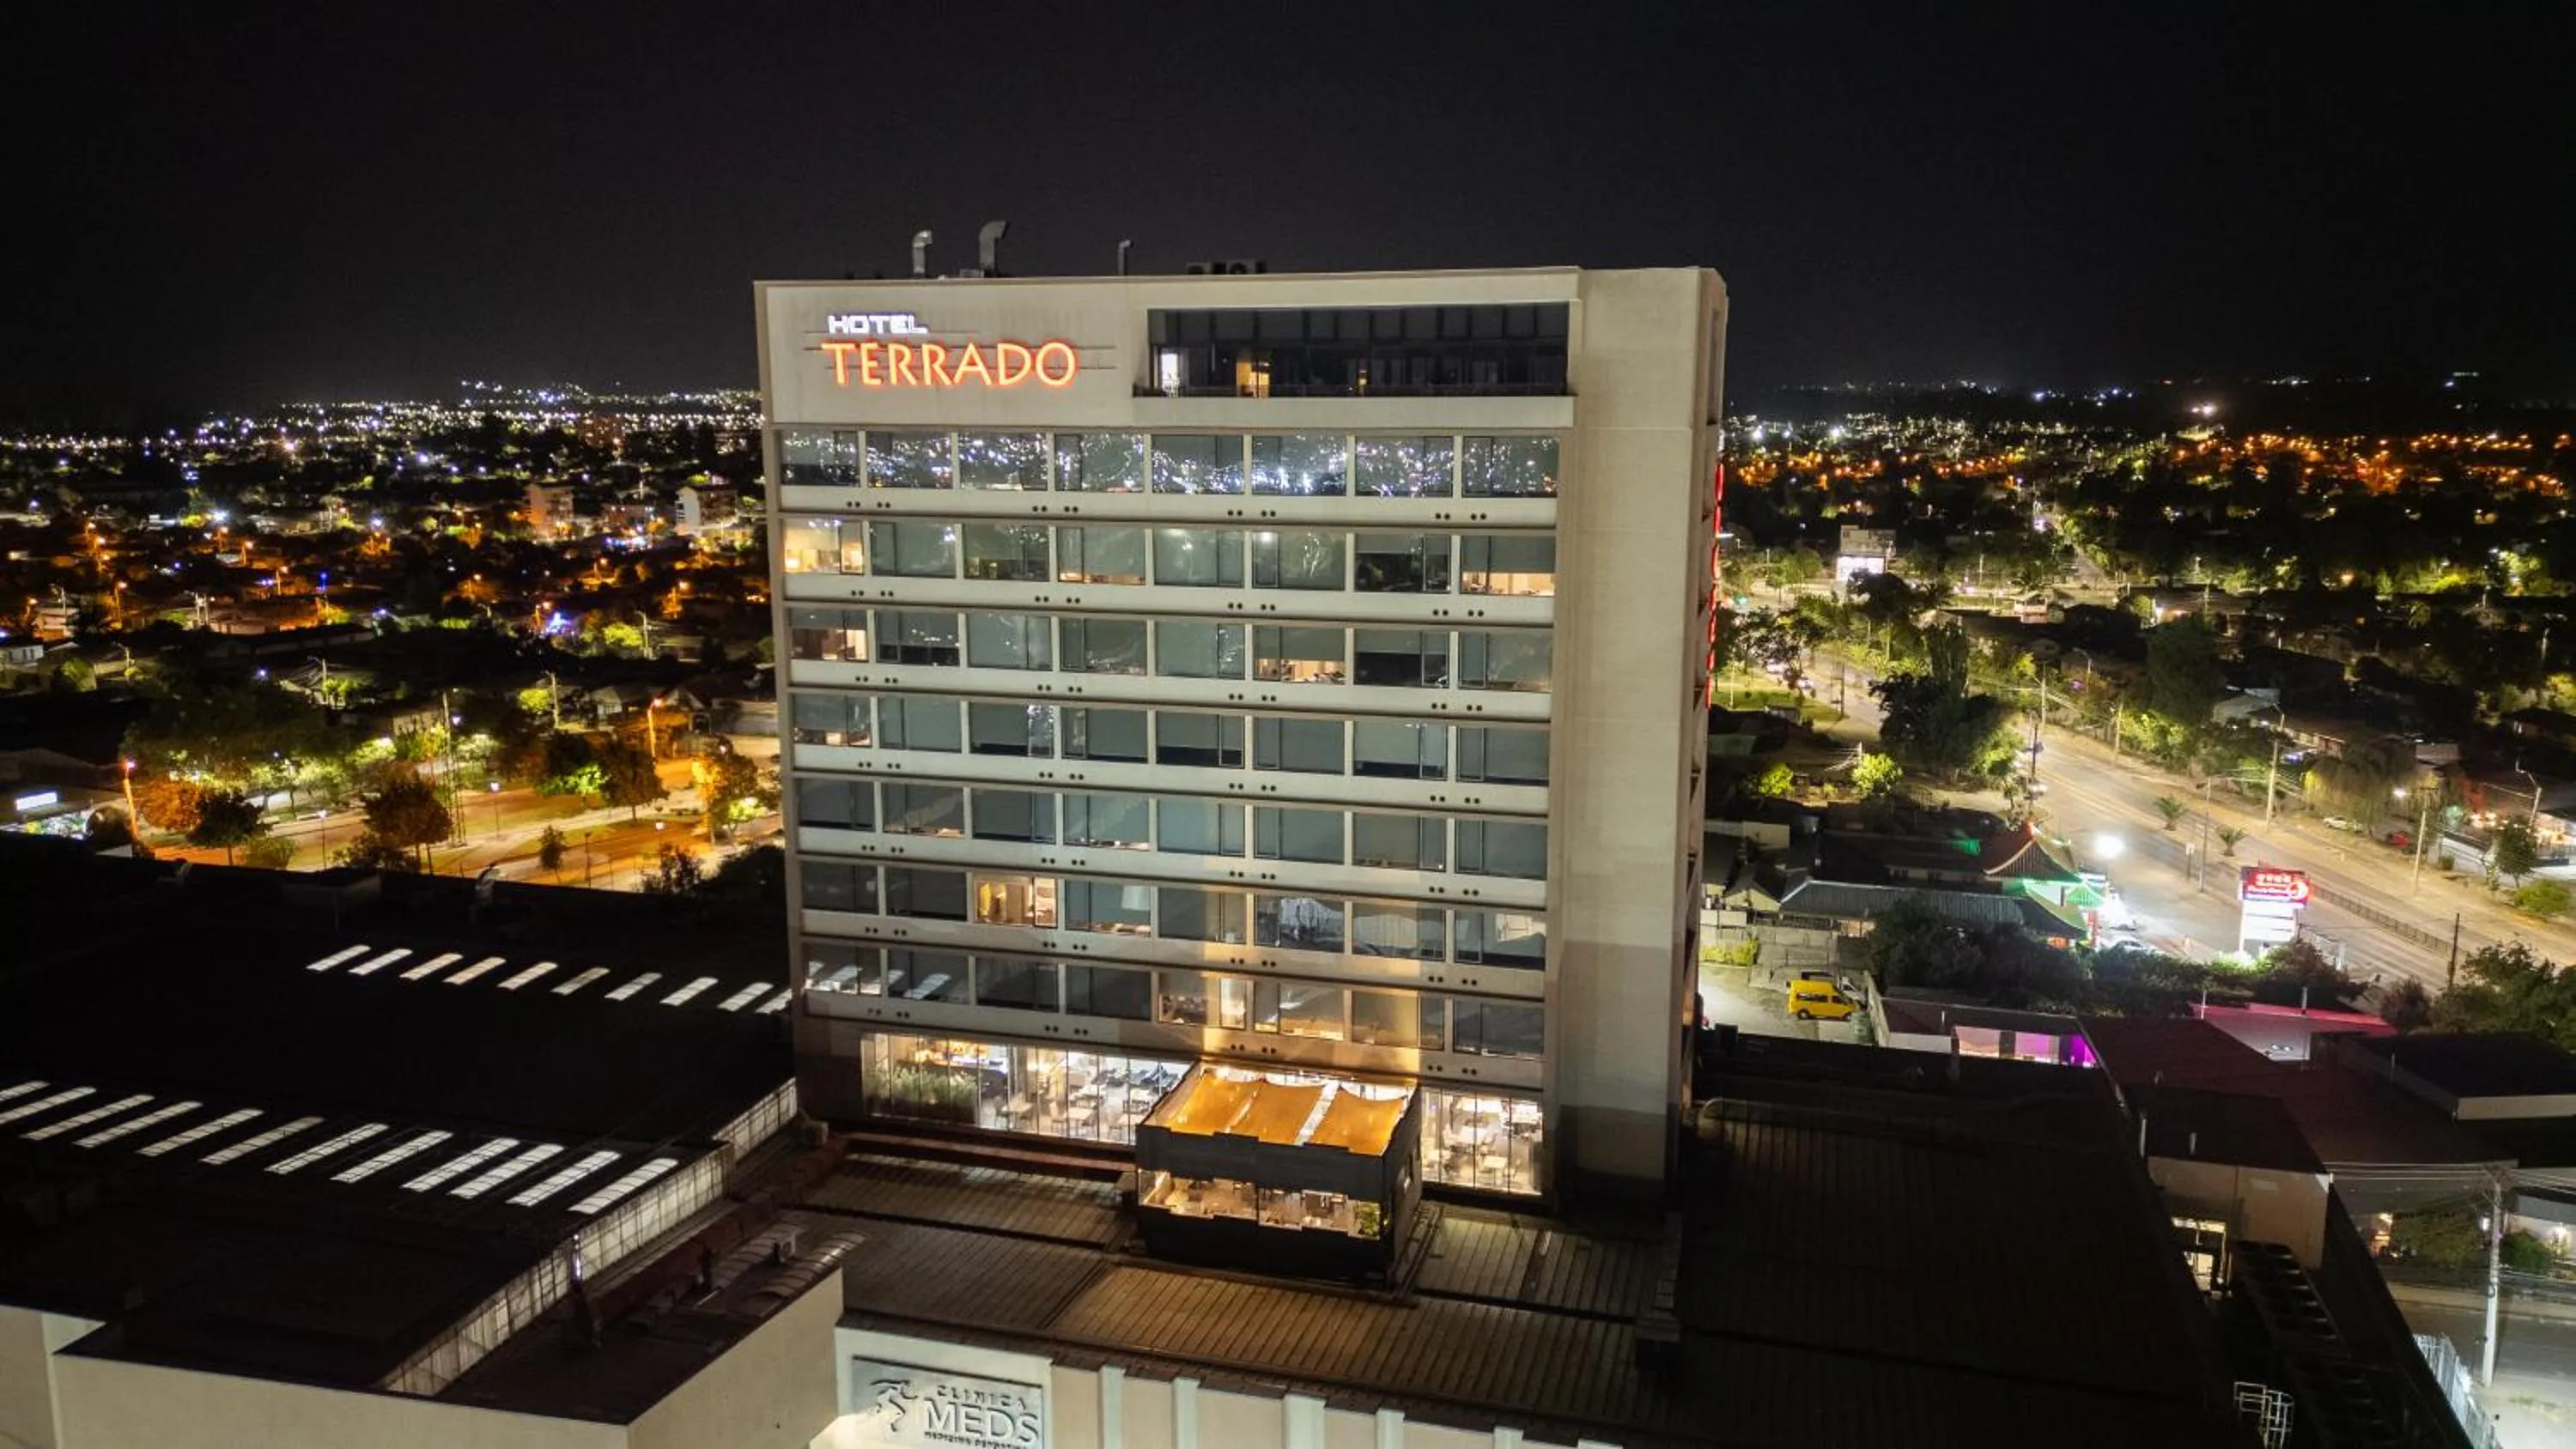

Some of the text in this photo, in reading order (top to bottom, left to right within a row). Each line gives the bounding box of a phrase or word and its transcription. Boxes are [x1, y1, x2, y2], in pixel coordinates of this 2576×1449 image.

[827, 314, 929, 335] HOTEL
[821, 341, 1078, 387] TERRADO
[923, 1397, 1040, 1444] MEDS
